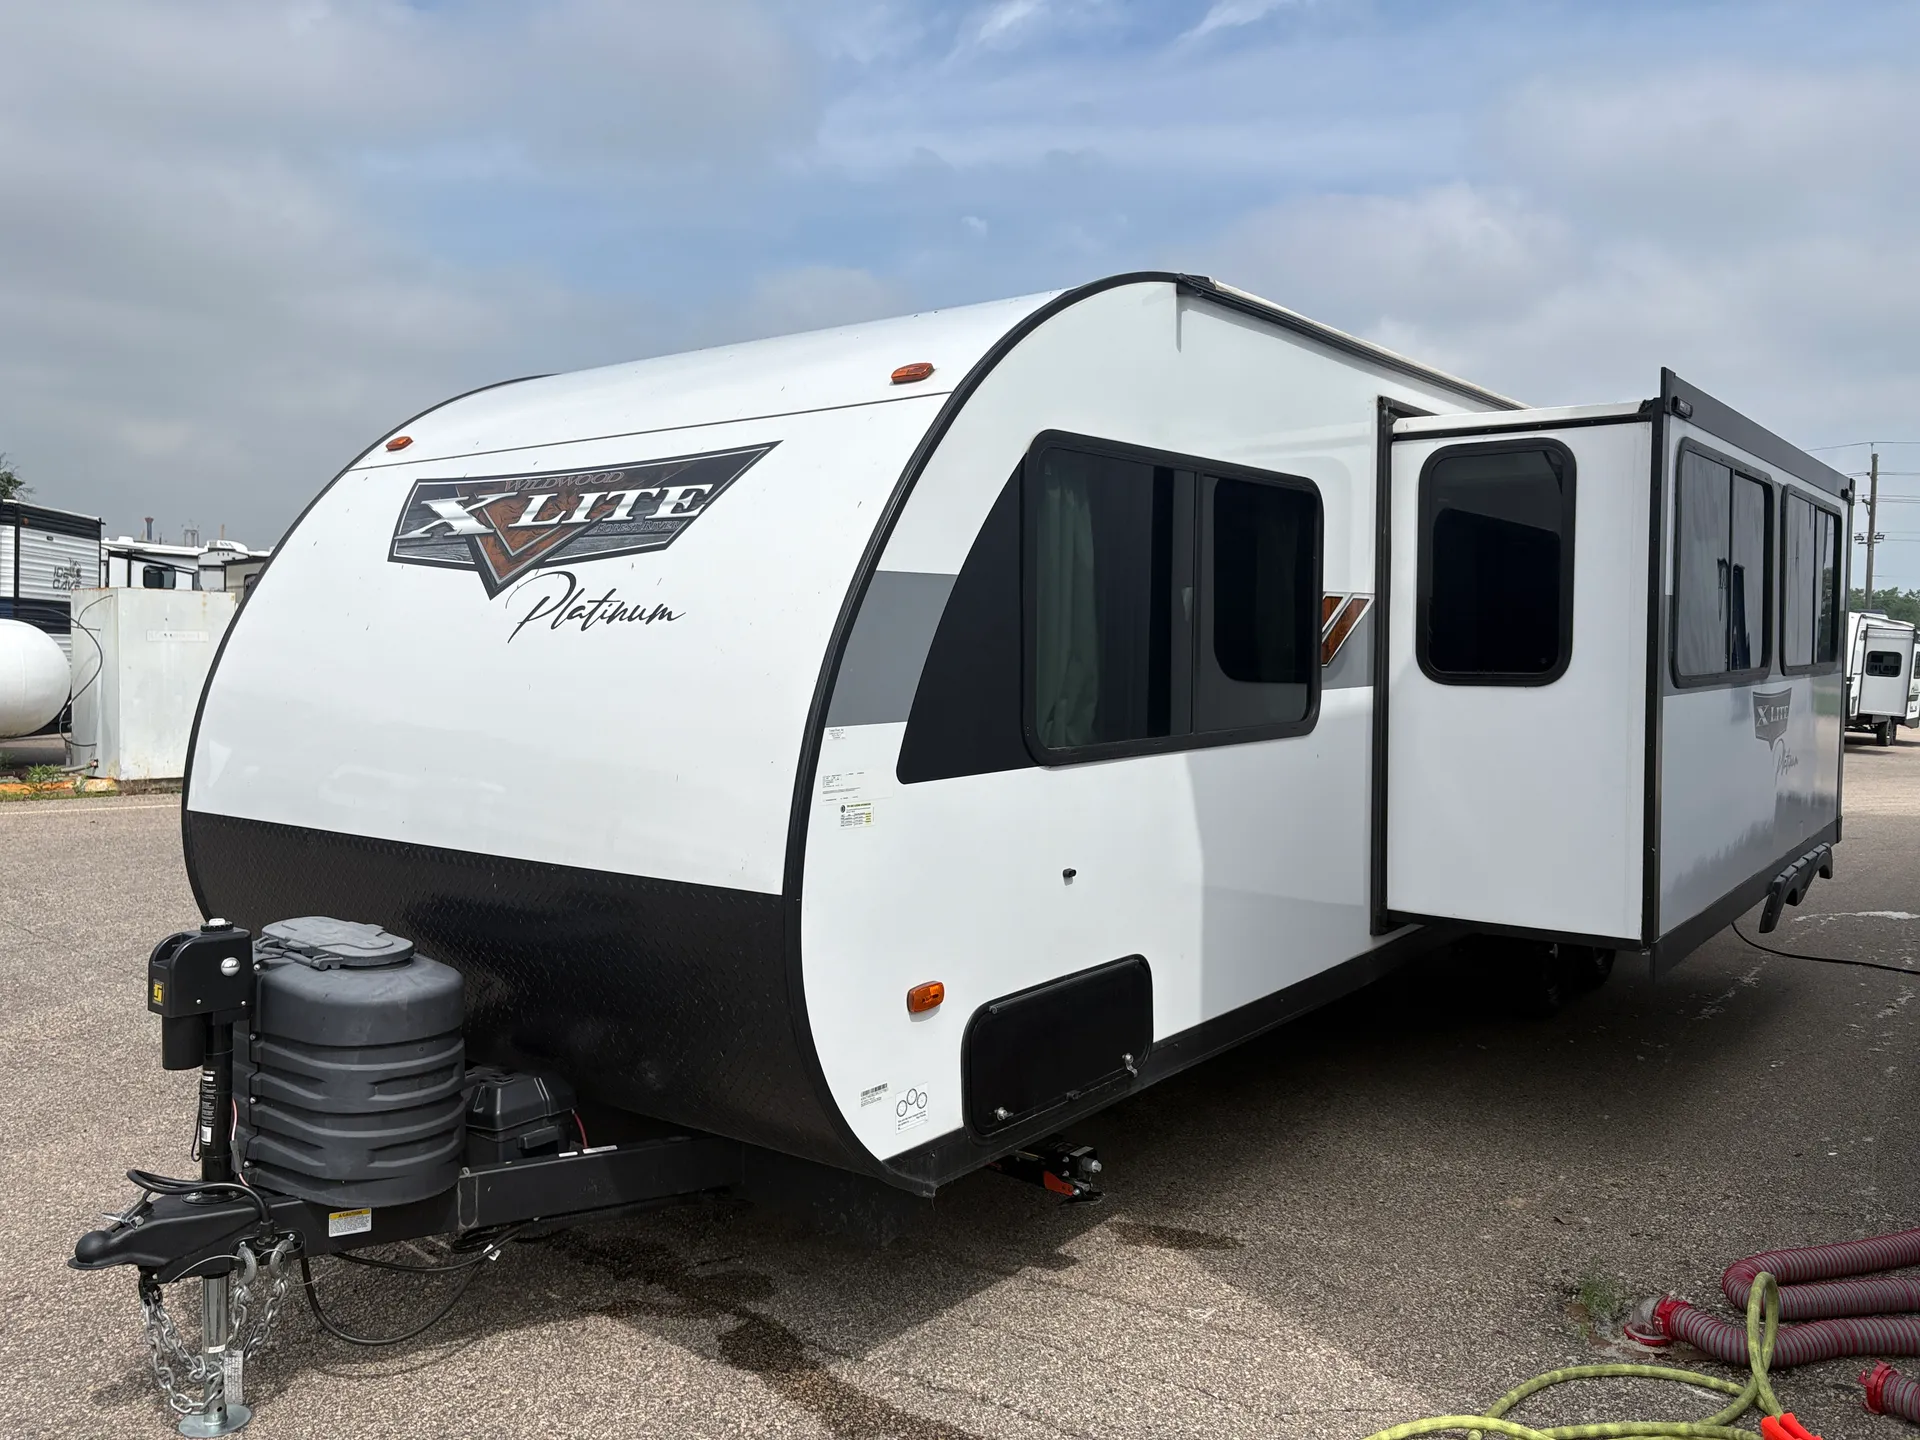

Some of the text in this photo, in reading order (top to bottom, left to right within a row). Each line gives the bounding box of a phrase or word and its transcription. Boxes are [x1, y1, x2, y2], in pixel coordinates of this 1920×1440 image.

[504, 471, 625, 492] WILDWOOD
[394, 484, 714, 539] X LITE
[596, 519, 681, 534] FOREST RIVER
[505, 570, 687, 644] Platinum
[1757, 704, 1789, 727] X LITE
